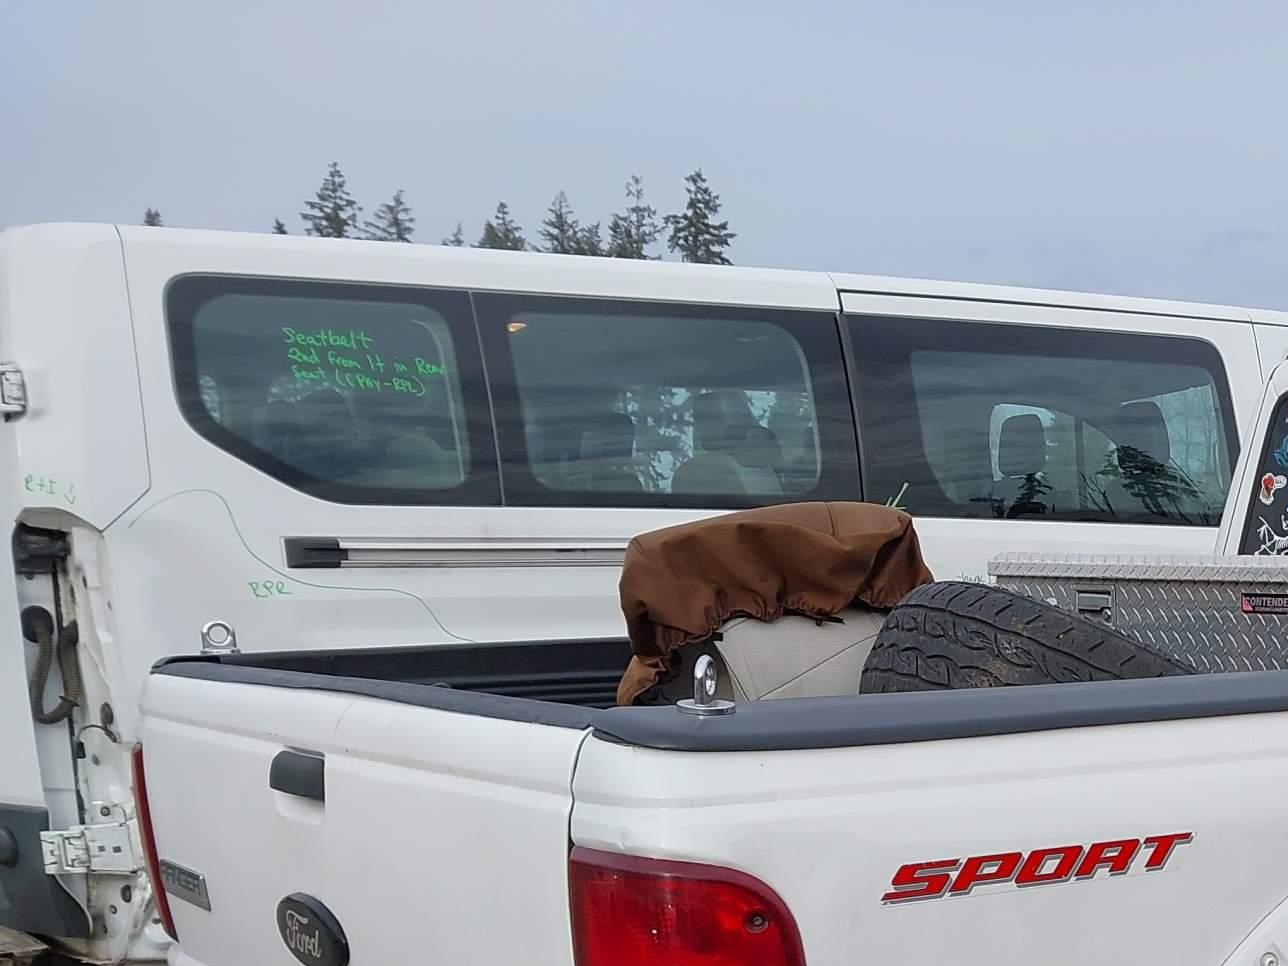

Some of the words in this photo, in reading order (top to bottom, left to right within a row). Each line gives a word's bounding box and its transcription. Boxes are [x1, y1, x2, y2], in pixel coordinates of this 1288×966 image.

[282, 327, 373, 349] Seatbelt
[291, 364, 326, 379] Seat
[414, 357, 447, 376] Rear
[249, 580, 292, 598] RPR
[878, 831, 1195, 905] SPORT
[286, 909, 322, 958] Ford
